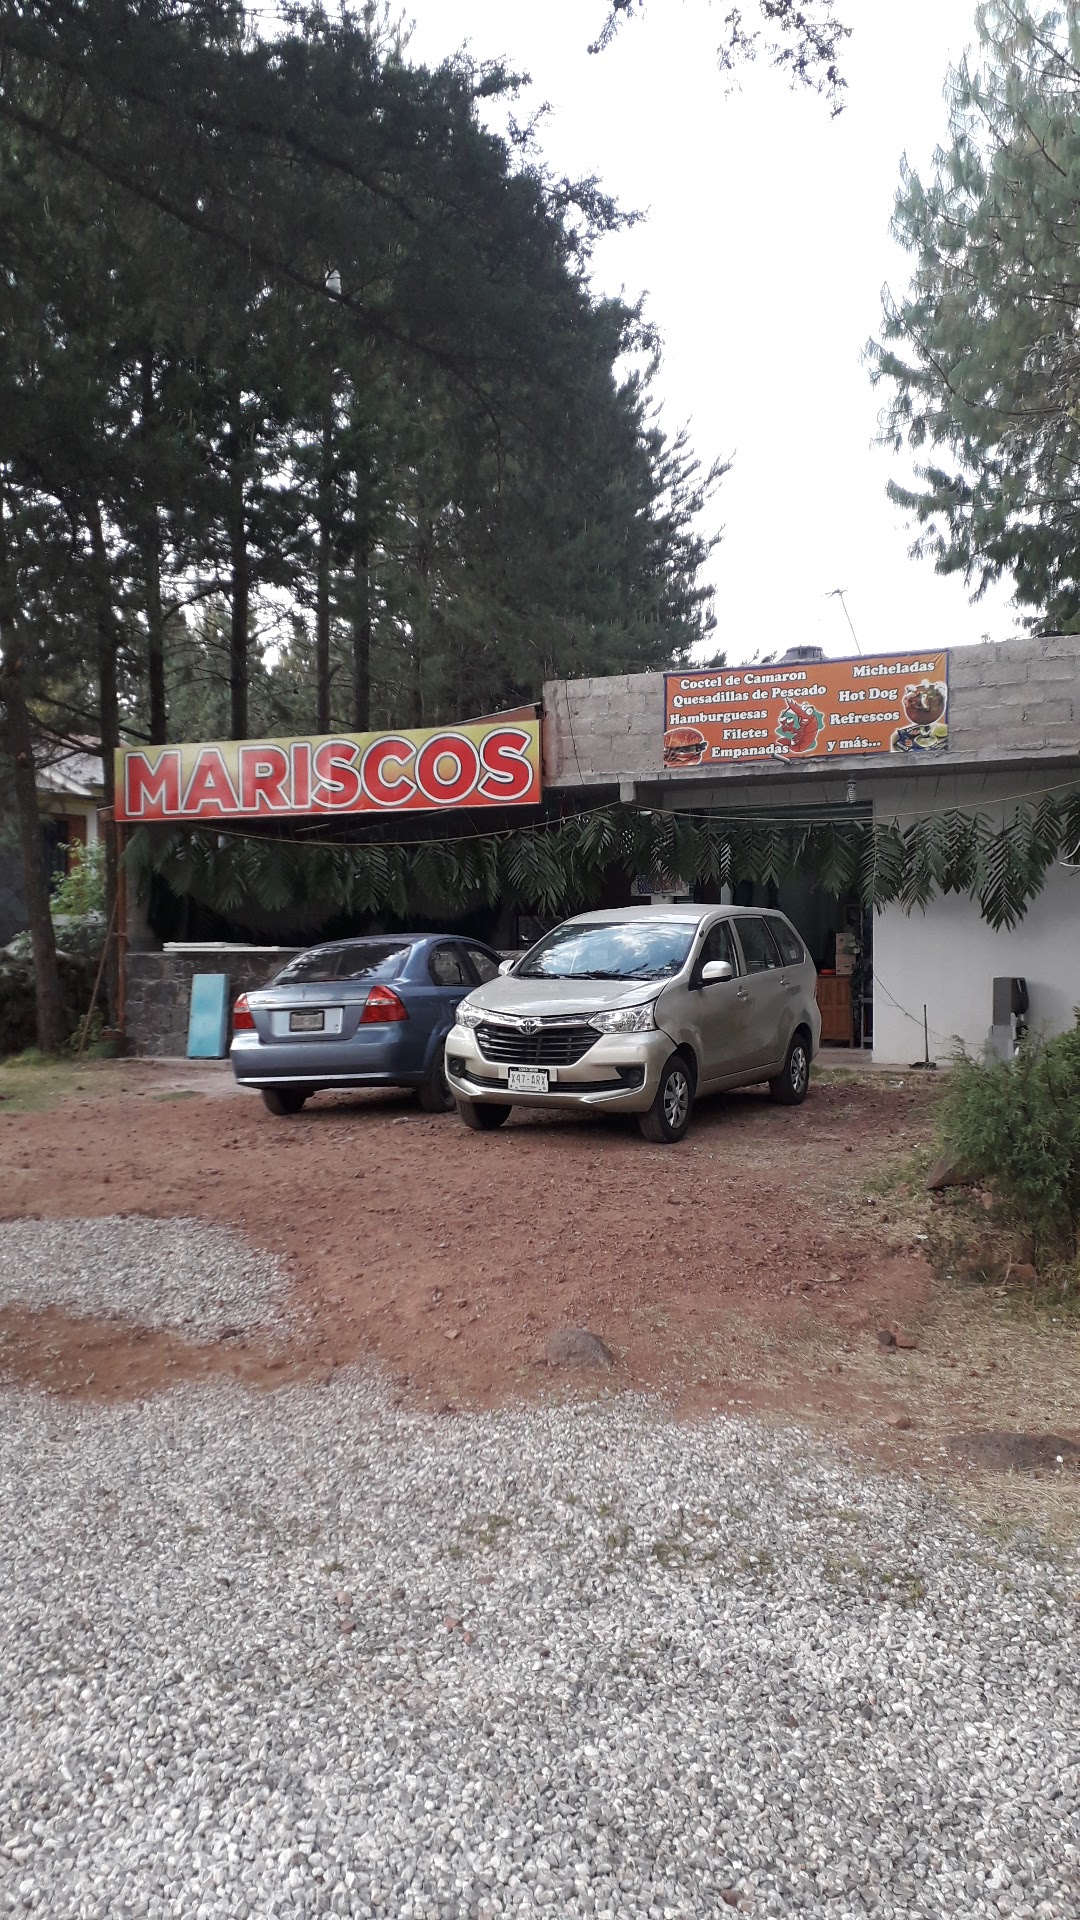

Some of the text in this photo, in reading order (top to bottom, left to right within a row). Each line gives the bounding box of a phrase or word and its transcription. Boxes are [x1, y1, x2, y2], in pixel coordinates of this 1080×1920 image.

[852, 661, 935, 678] Micheladas
[681, 670, 806, 690] Coctel de Camaron
[673, 684, 827, 707] Quesadillas de Pescado
[838, 688, 898, 702] Hot Dog
[669, 709, 768, 725] Hamburguesas
[829, 710, 900, 725] Refrescos
[723, 728, 768, 740] Filetes
[711, 744, 789, 758] Empanadas
[827, 741, 835, 752] y
[125, 727, 534, 816] MARISCOS
